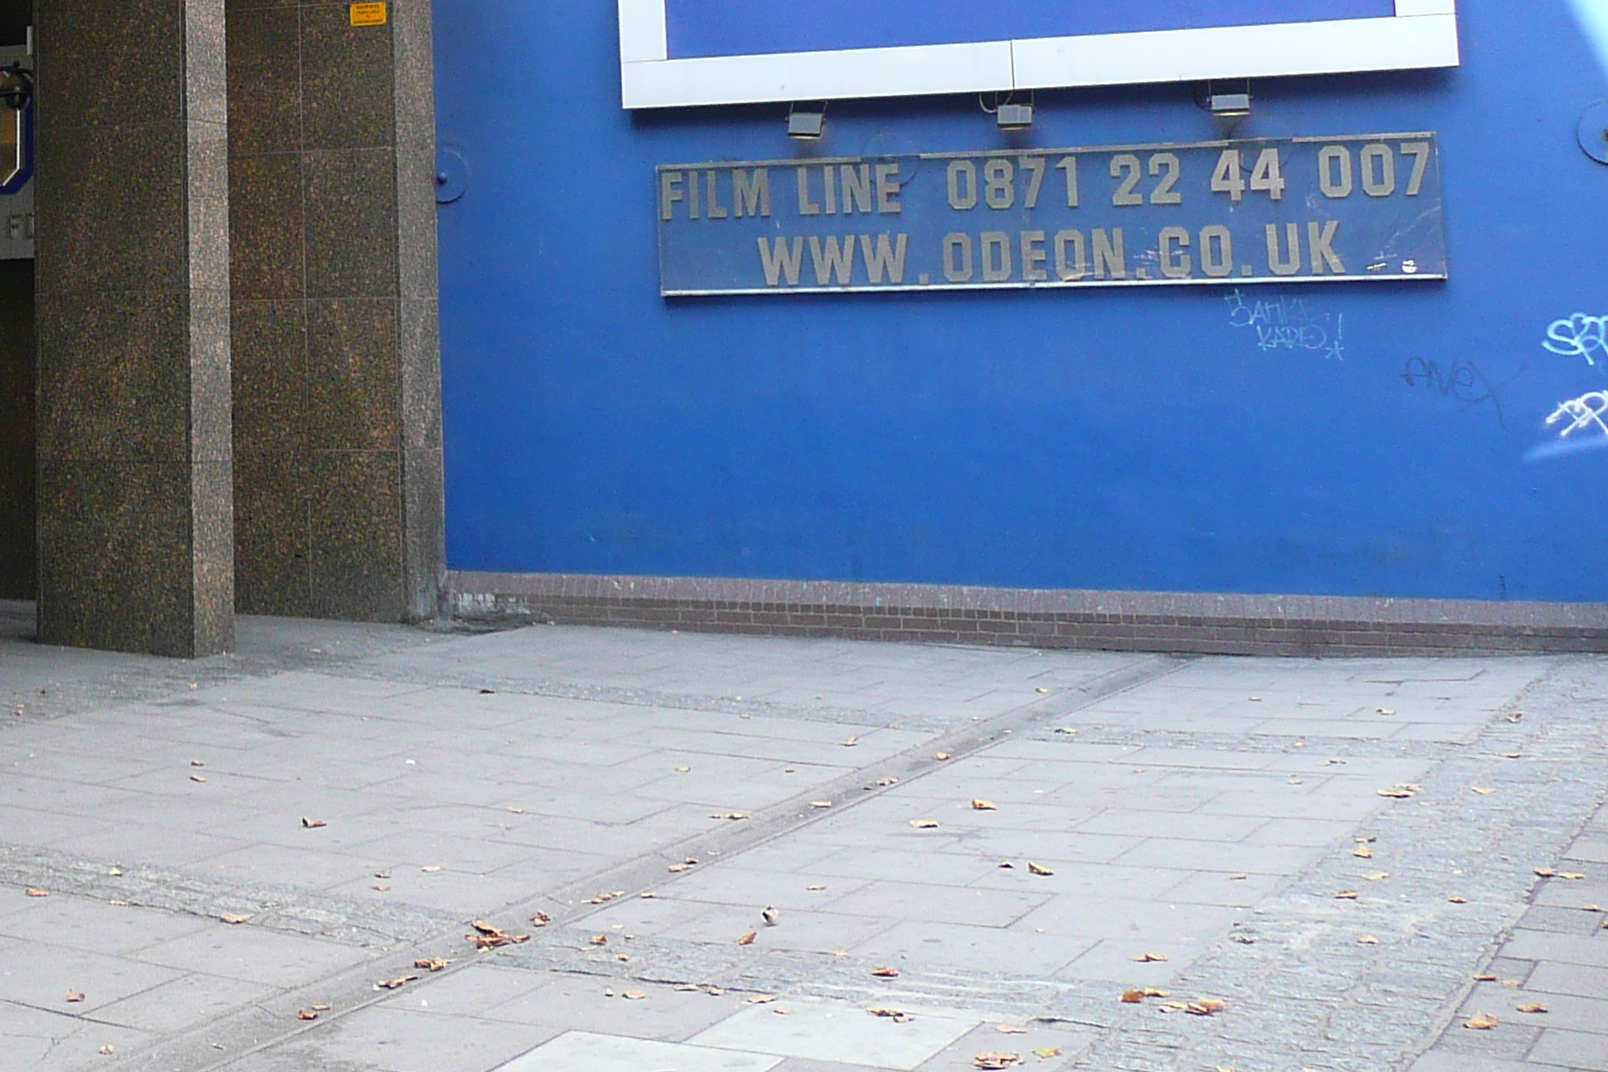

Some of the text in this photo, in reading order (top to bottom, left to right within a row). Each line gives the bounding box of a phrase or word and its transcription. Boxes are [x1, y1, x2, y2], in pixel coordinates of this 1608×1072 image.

[661, 141, 1431, 220] FILM LINE 0871 22 44 007
[757, 220, 1345, 286] WWW.ODEON.CO.UK
